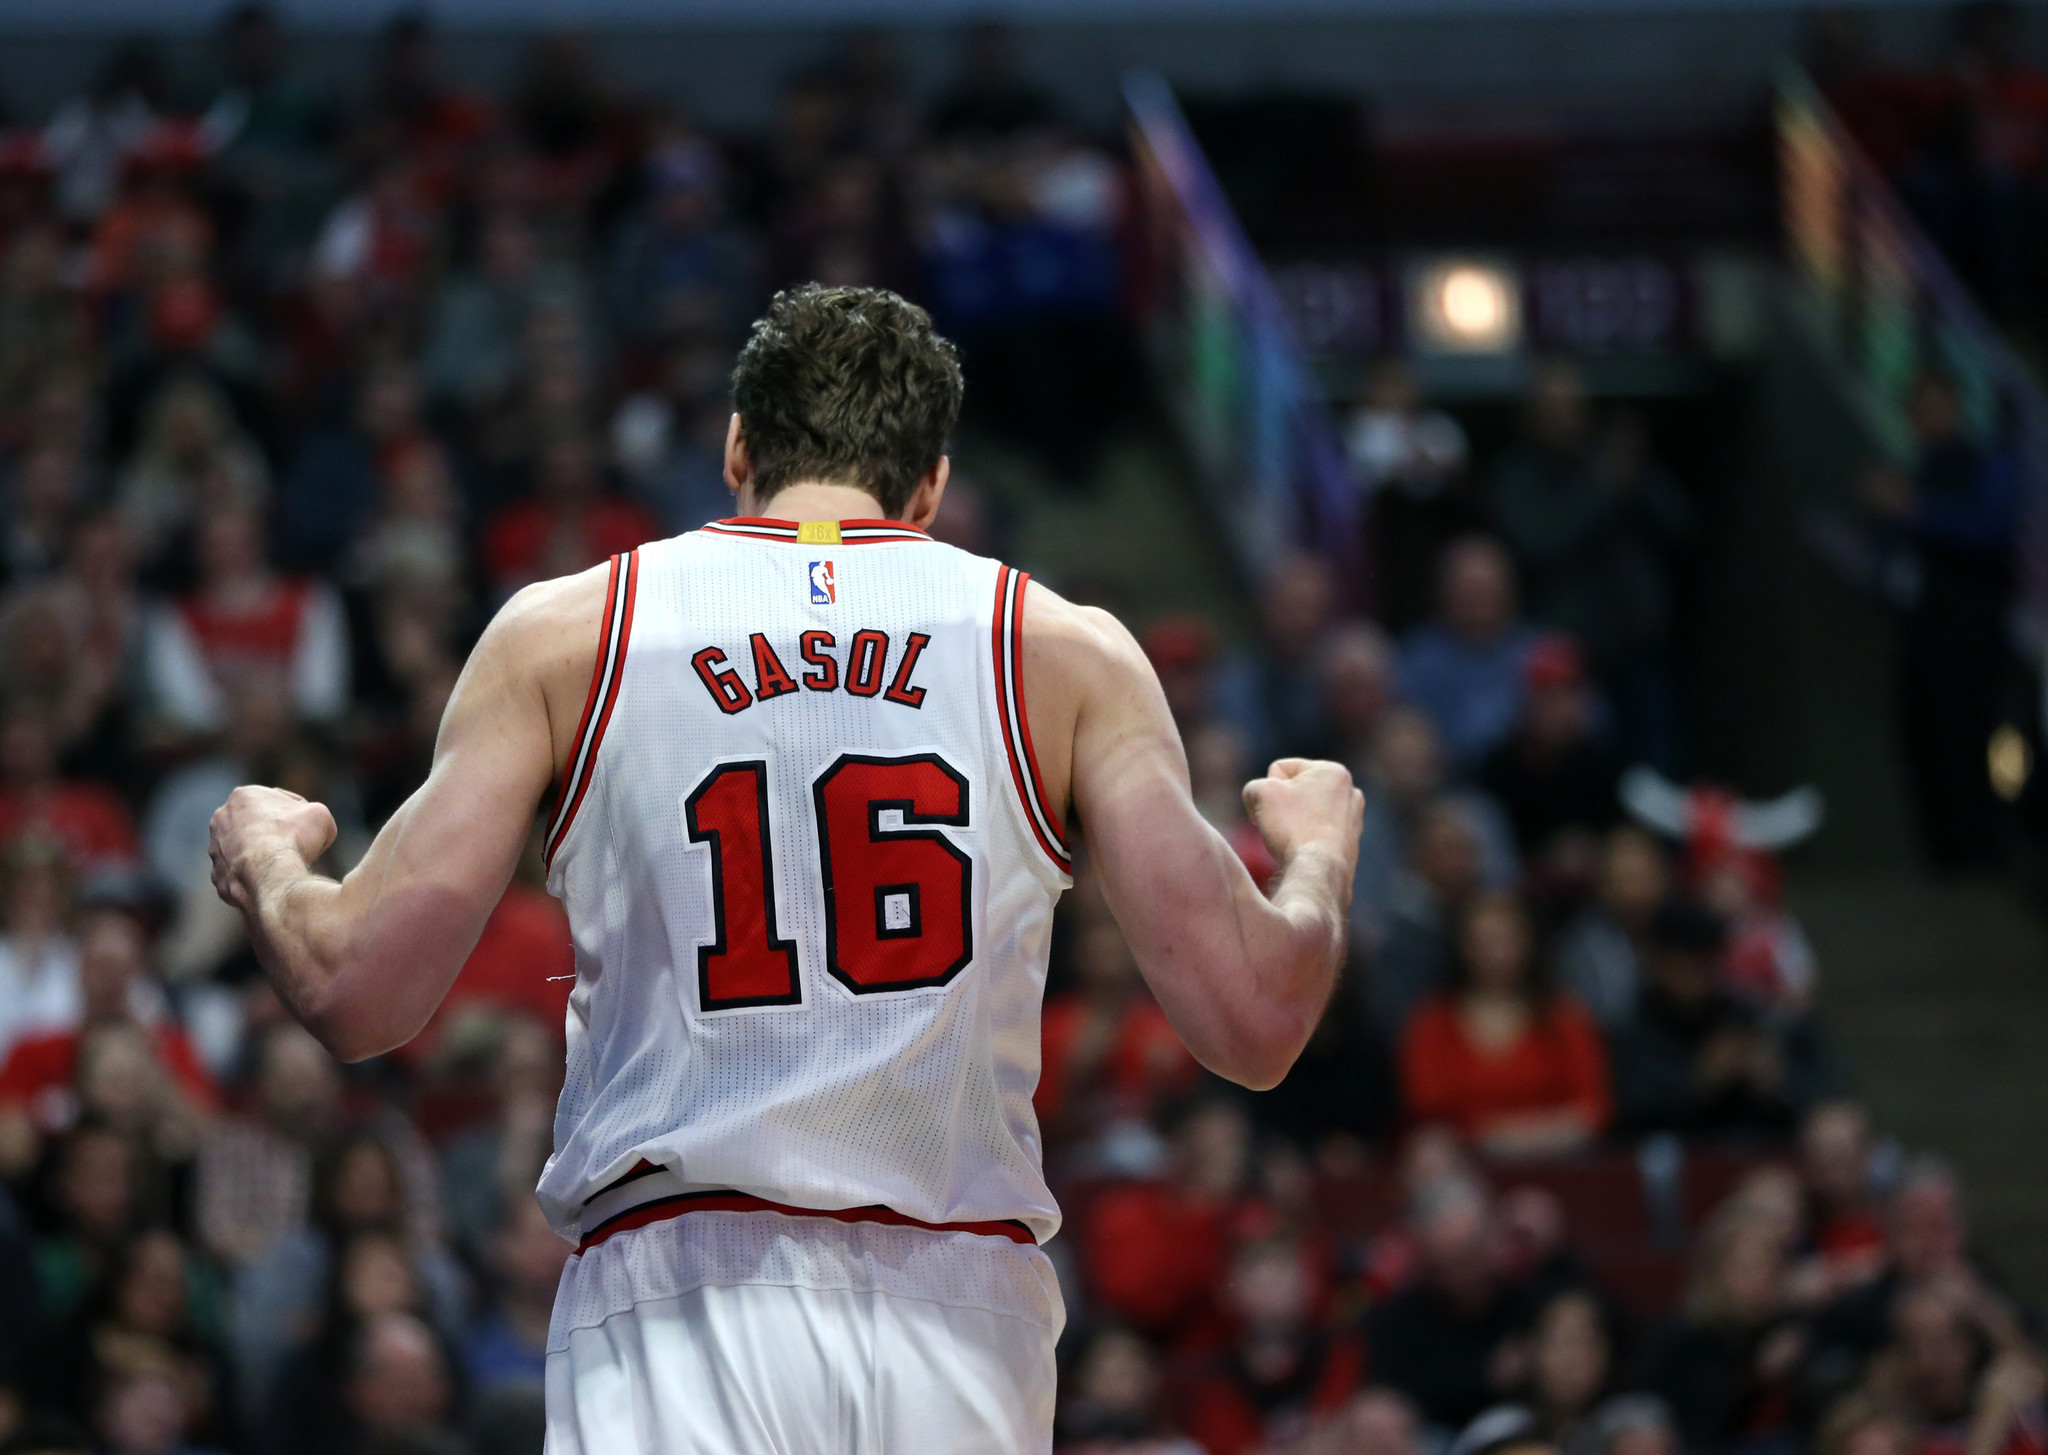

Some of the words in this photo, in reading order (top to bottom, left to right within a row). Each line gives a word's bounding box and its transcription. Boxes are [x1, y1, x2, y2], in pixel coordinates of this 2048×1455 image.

[812, 594, 829, 603] NBA
[690, 628, 931, 715] GASOL
[684, 752, 973, 1012] 16
